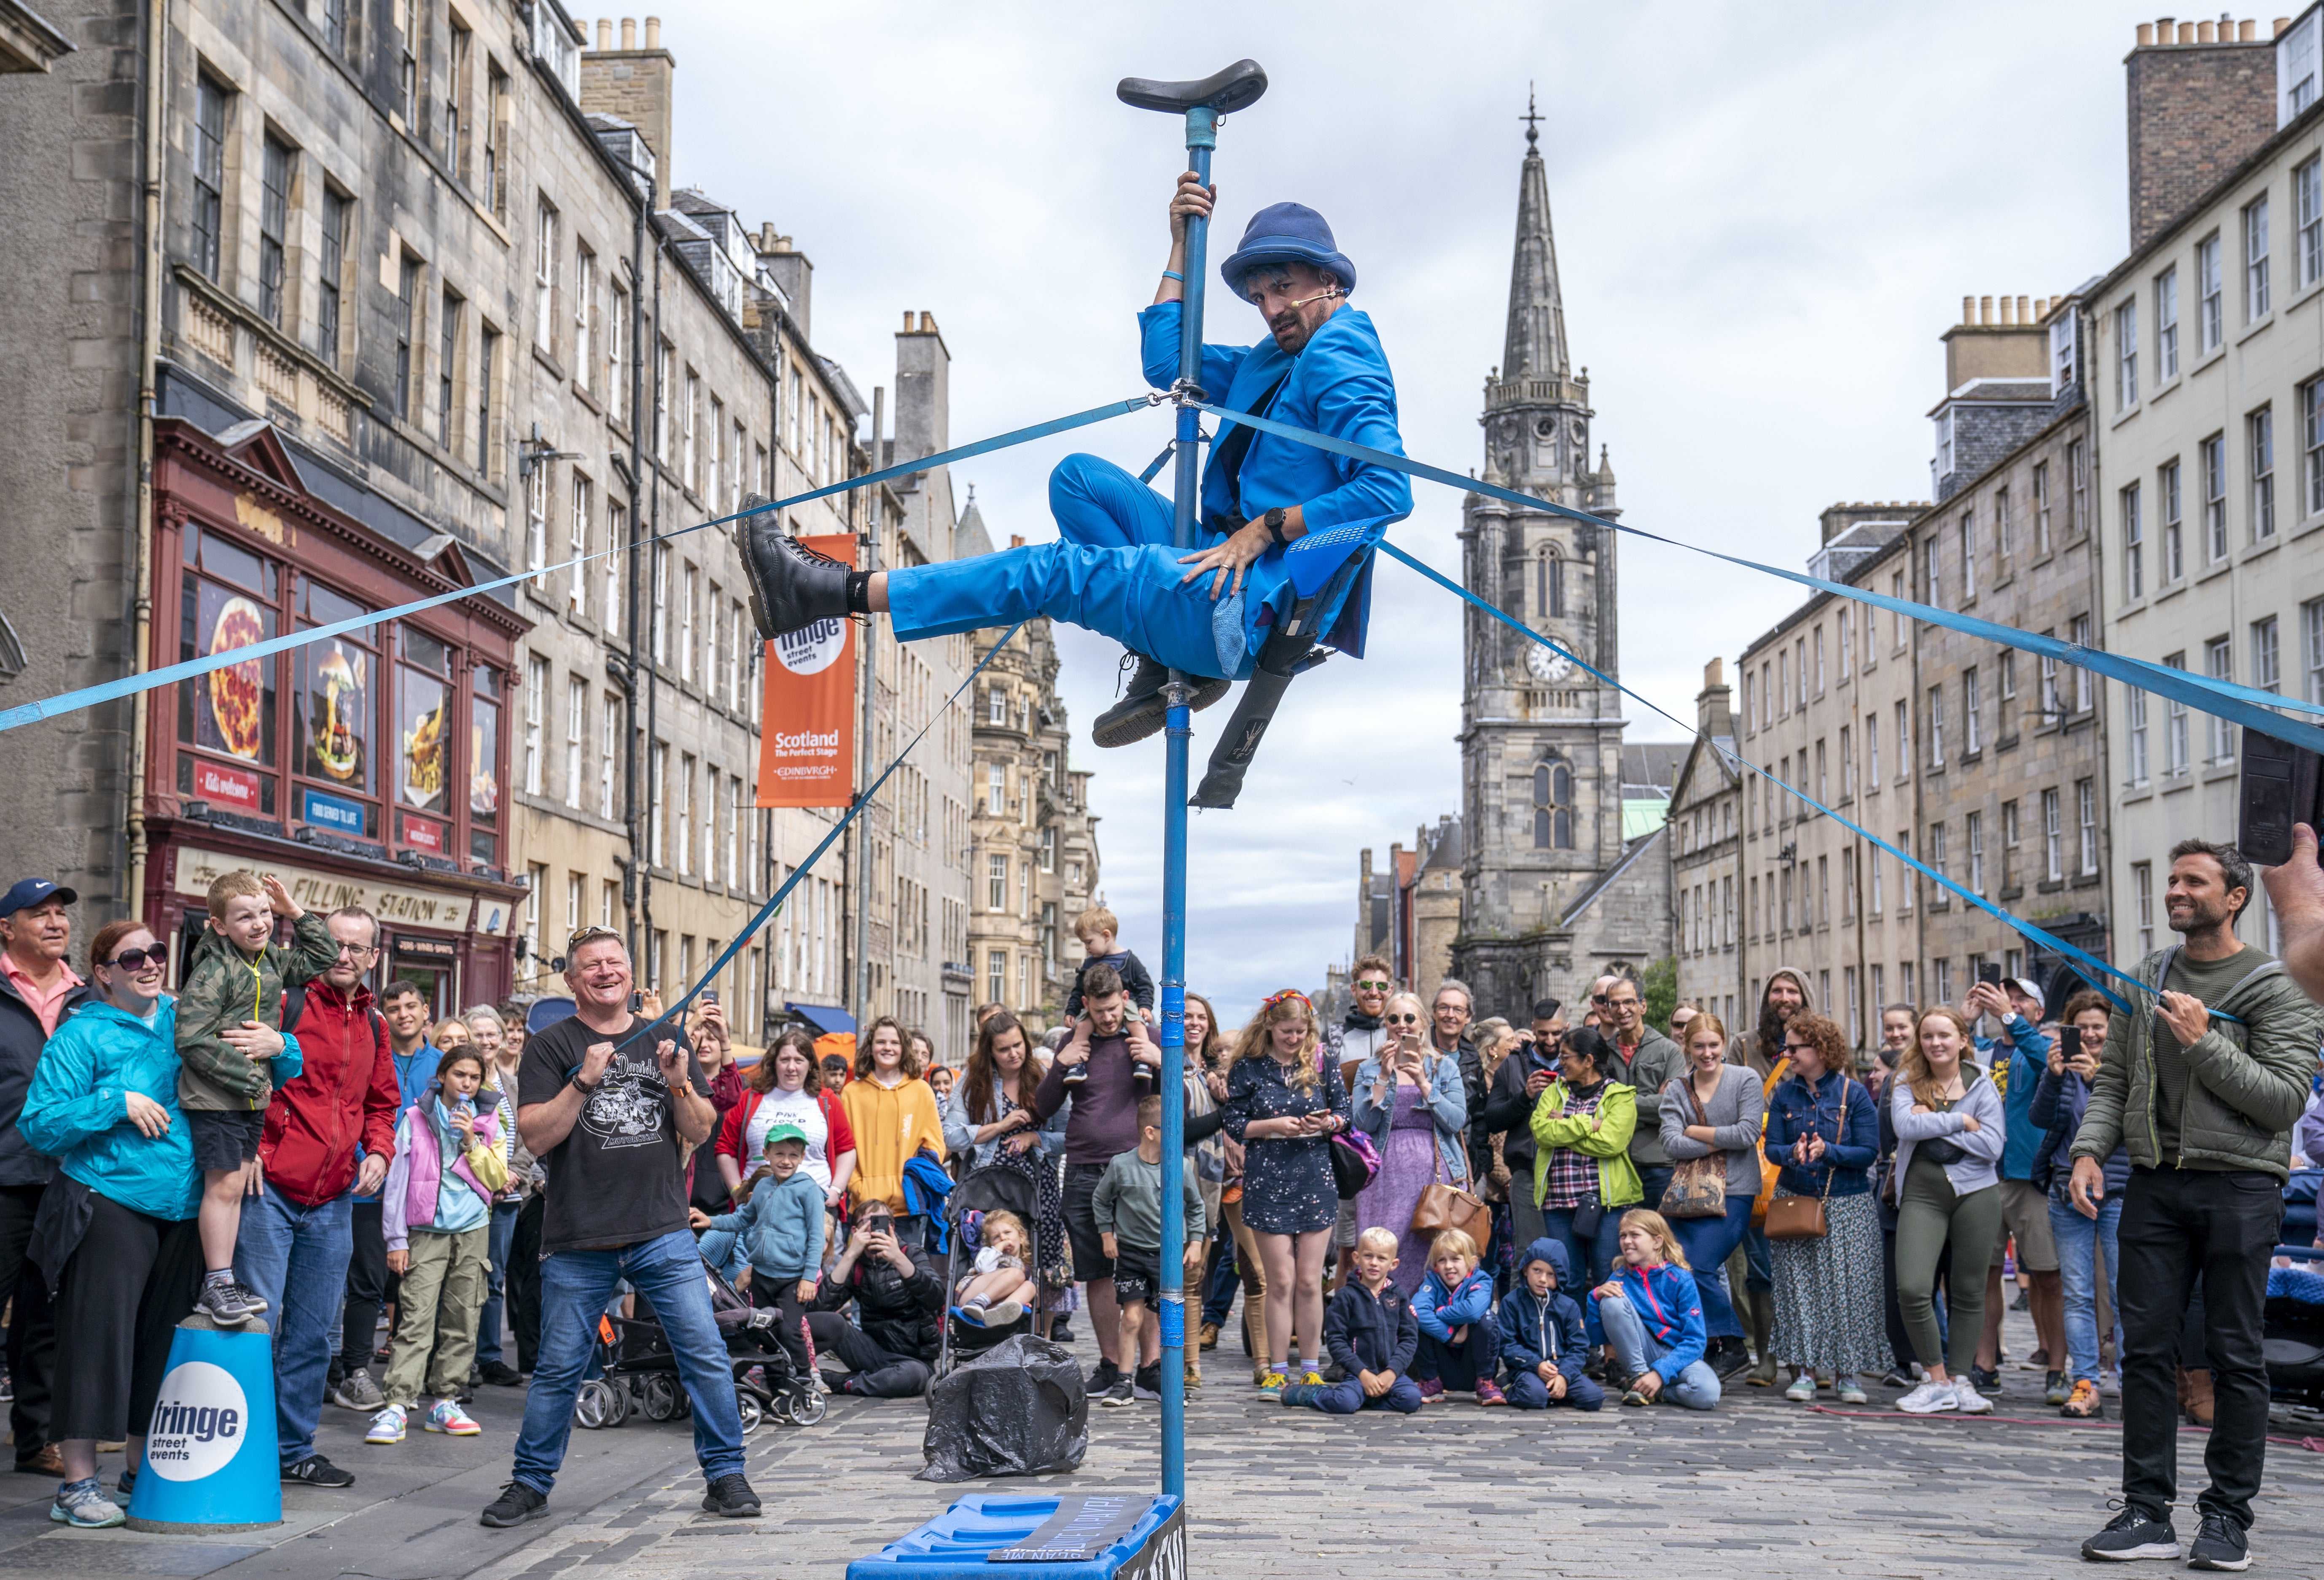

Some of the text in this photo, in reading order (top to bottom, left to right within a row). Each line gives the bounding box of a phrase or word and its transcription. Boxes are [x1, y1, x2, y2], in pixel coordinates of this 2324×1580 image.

[787, 645, 812, 659] street
[788, 653, 817, 667] events
[775, 729, 839, 749] Scotland
[775, 747, 838, 757] The Perfect Stage
[220, 776, 249, 800] welcome
[312, 802, 324, 818] FOOD
[323, 805, 339, 821] SERVED
[292, 877, 437, 921] FILLING STATION
[153, 1400, 238, 1442] fringe
[152, 1437, 187, 1448] street
[150, 1449, 189, 1460] events
[1073, 1497, 1128, 1521] PAYPA
